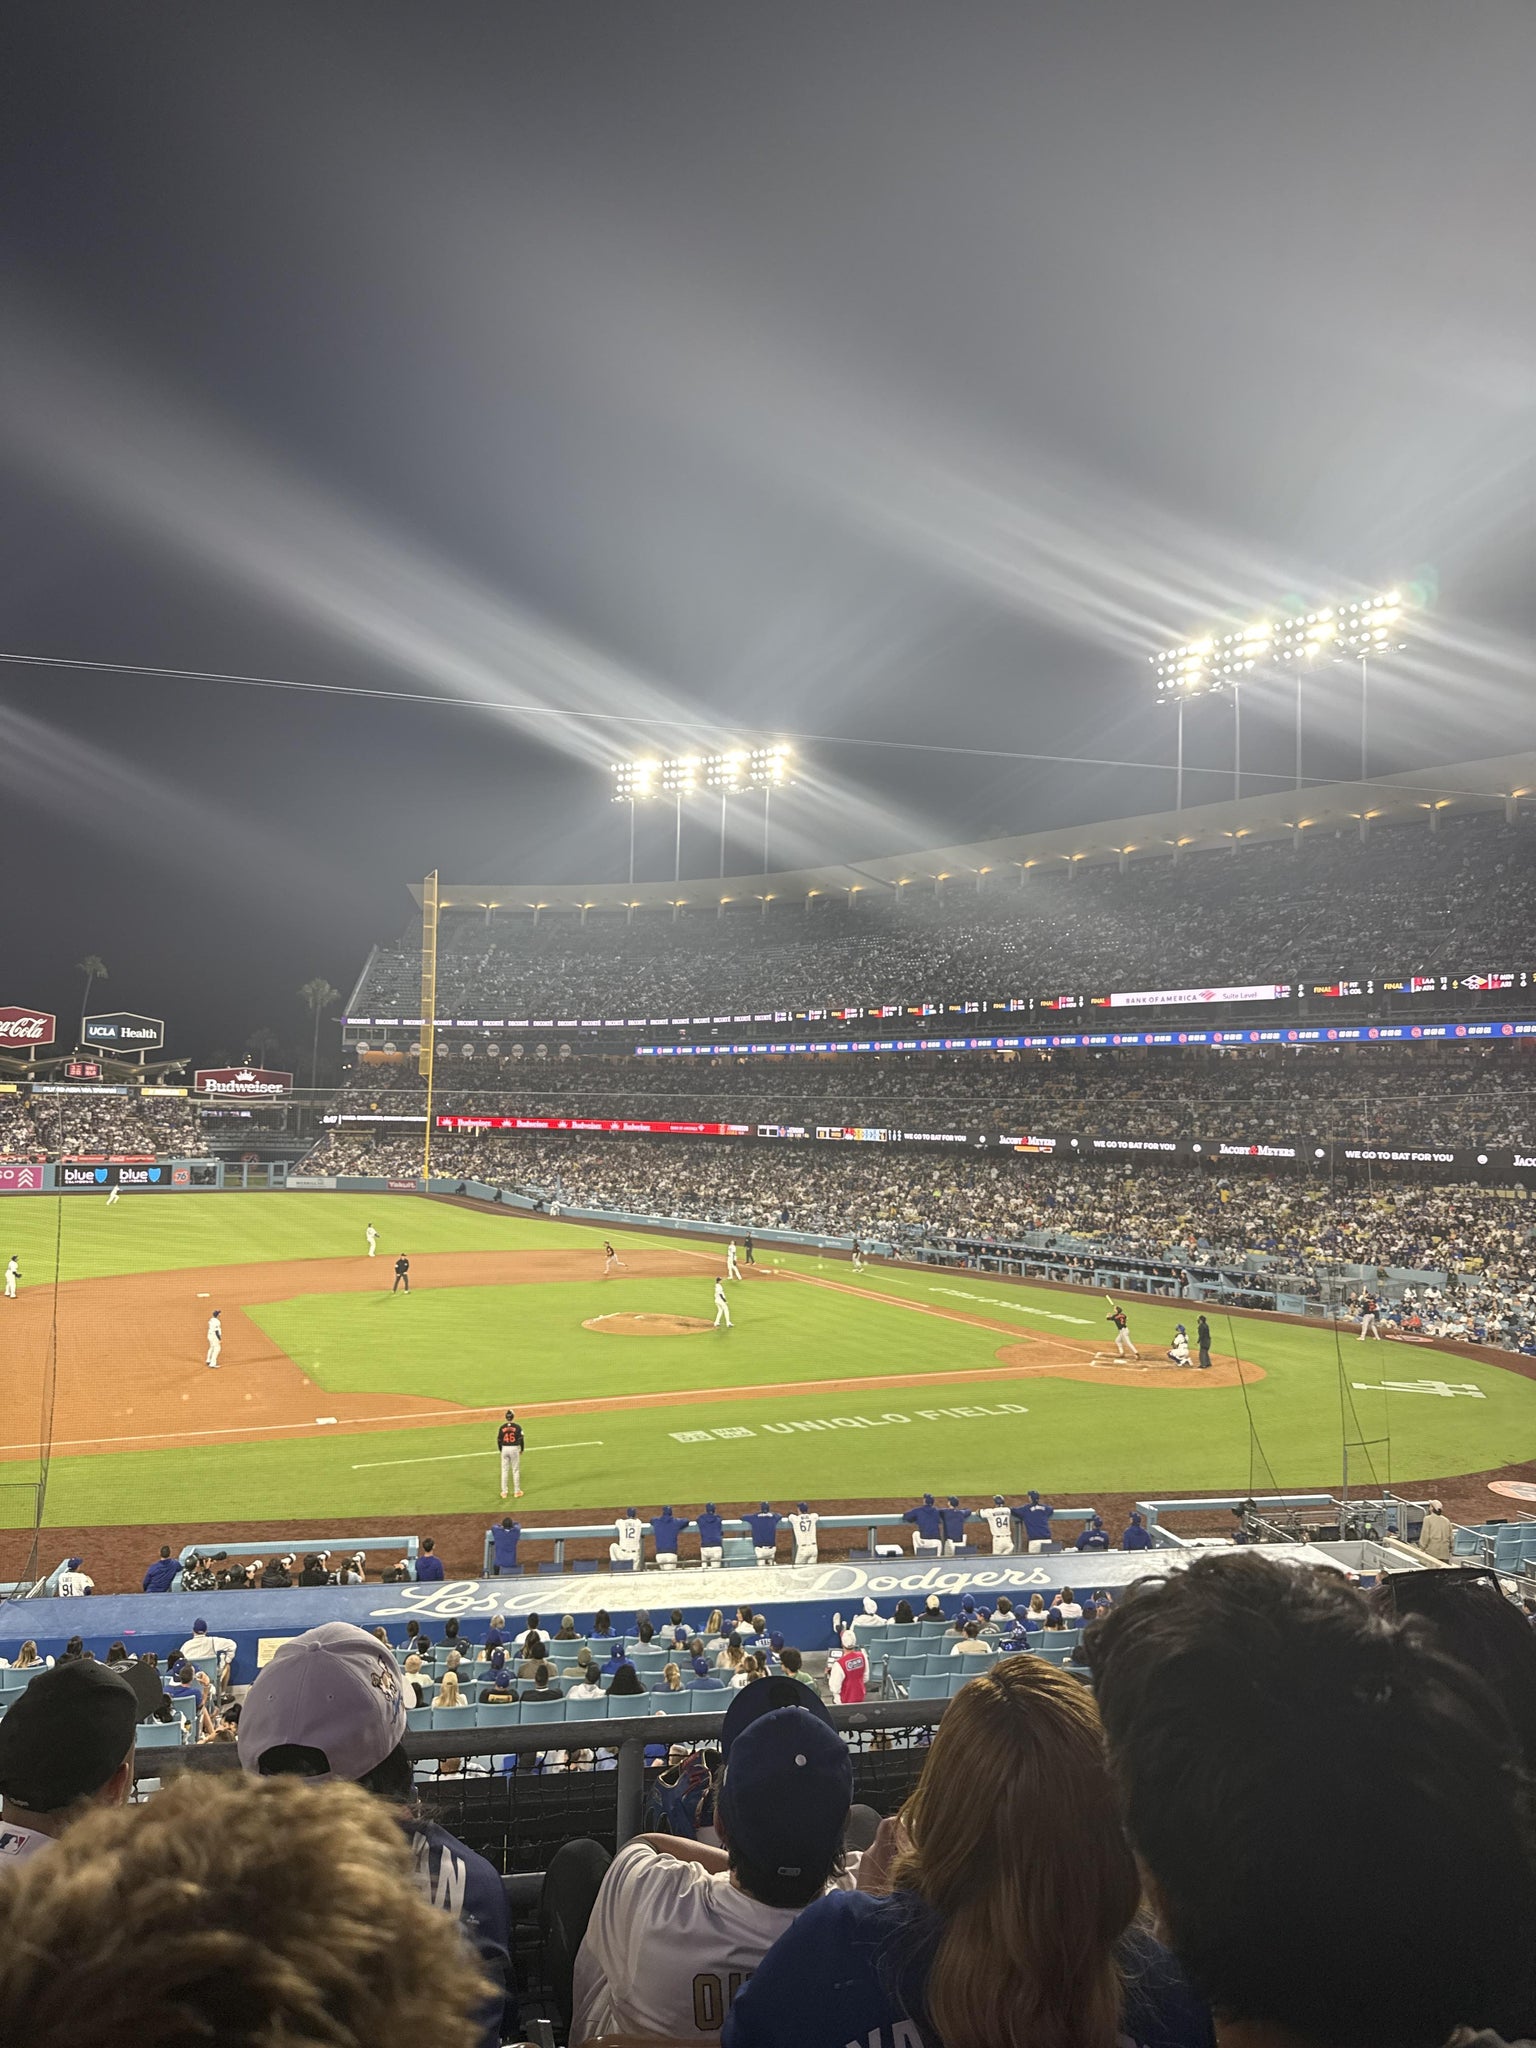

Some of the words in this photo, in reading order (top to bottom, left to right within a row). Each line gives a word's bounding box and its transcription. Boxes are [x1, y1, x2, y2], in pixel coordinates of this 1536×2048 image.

[0, 1017, 47, 1038] a-Cola
[88, 1027, 115, 1037] UCLA
[121, 1028, 157, 1039] Health
[205, 1079, 282, 1093] Budweiser
[1094, 1140, 1105, 1148] WE
[1118, 1141, 1128, 1149] TO
[1144, 1142, 1159, 1150] FOR
[1160, 1143, 1176, 1151] YOU
[1345, 1150, 1361, 1159] WE
[1362, 1151, 1376, 1159] GO
[1377, 1151, 1391, 1160] TO
[1391, 1152, 1411, 1161] BAT
[1412, 1153, 1431, 1161] FOR
[1433, 1153, 1454, 1162] YOU
[65, 1169, 94, 1180] blue
[120, 1169, 148, 1179] blue
[761, 1413, 912, 1434] UNIQLO
[914, 1403, 1029, 1421] FIELD
[503, 1432, 516, 1443] 46
[800, 1520, 812, 1532] 67
[995, 1517, 1008, 1528] 84
[625, 1528, 635, 1539] 12
[62, 1583, 73, 1597] 91
[369, 1581, 501, 1618] Los
[791, 1564, 1051, 1595] Dodgers
